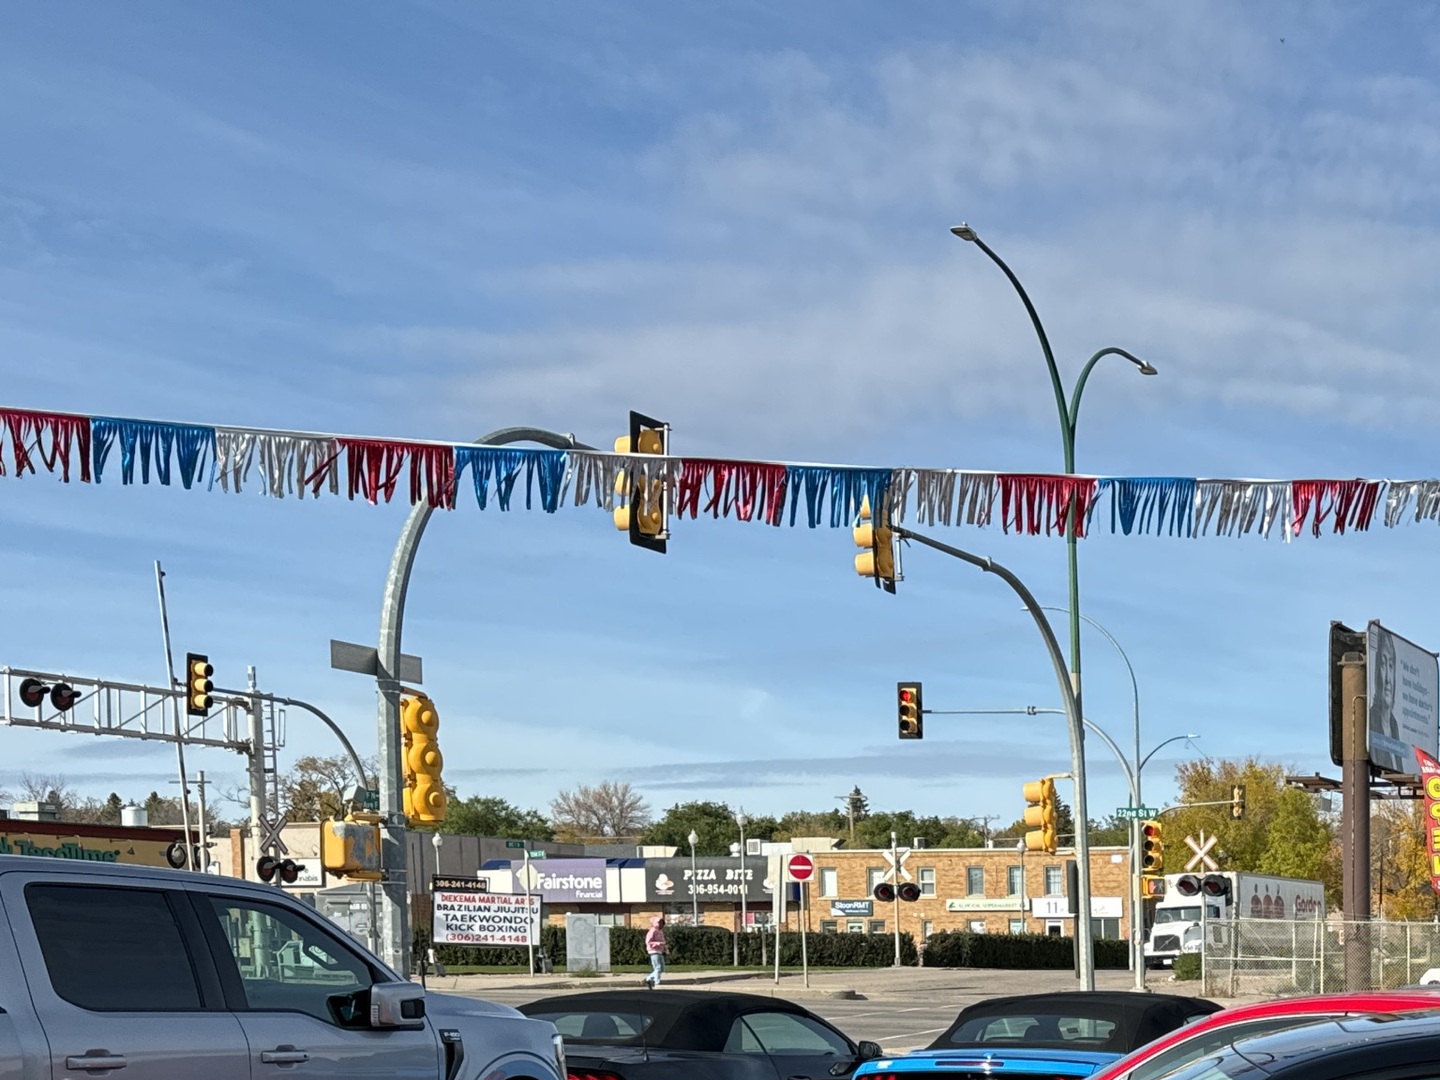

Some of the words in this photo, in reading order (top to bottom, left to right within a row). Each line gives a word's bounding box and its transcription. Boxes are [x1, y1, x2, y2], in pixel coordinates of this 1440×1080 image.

[1117, 809, 1136, 818] 22nd
[1138, 809, 1147, 818] St
[1148, 809, 1157, 818] W
[435, 880, 486, 889] 306-241-4148
[536, 873, 603, 890] Fairstone
[575, 891, 603, 899] Financial
[441, 894, 477, 903] DIEKEMA
[478, 895, 512, 905] MARTIAL
[514, 897, 535, 906] ARS
[436, 904, 491, 913] BRAZILIAN
[446, 923, 475, 932] KICK
[478, 924, 527, 934] BOXING
[446, 933, 527, 943] (306)241-4148
